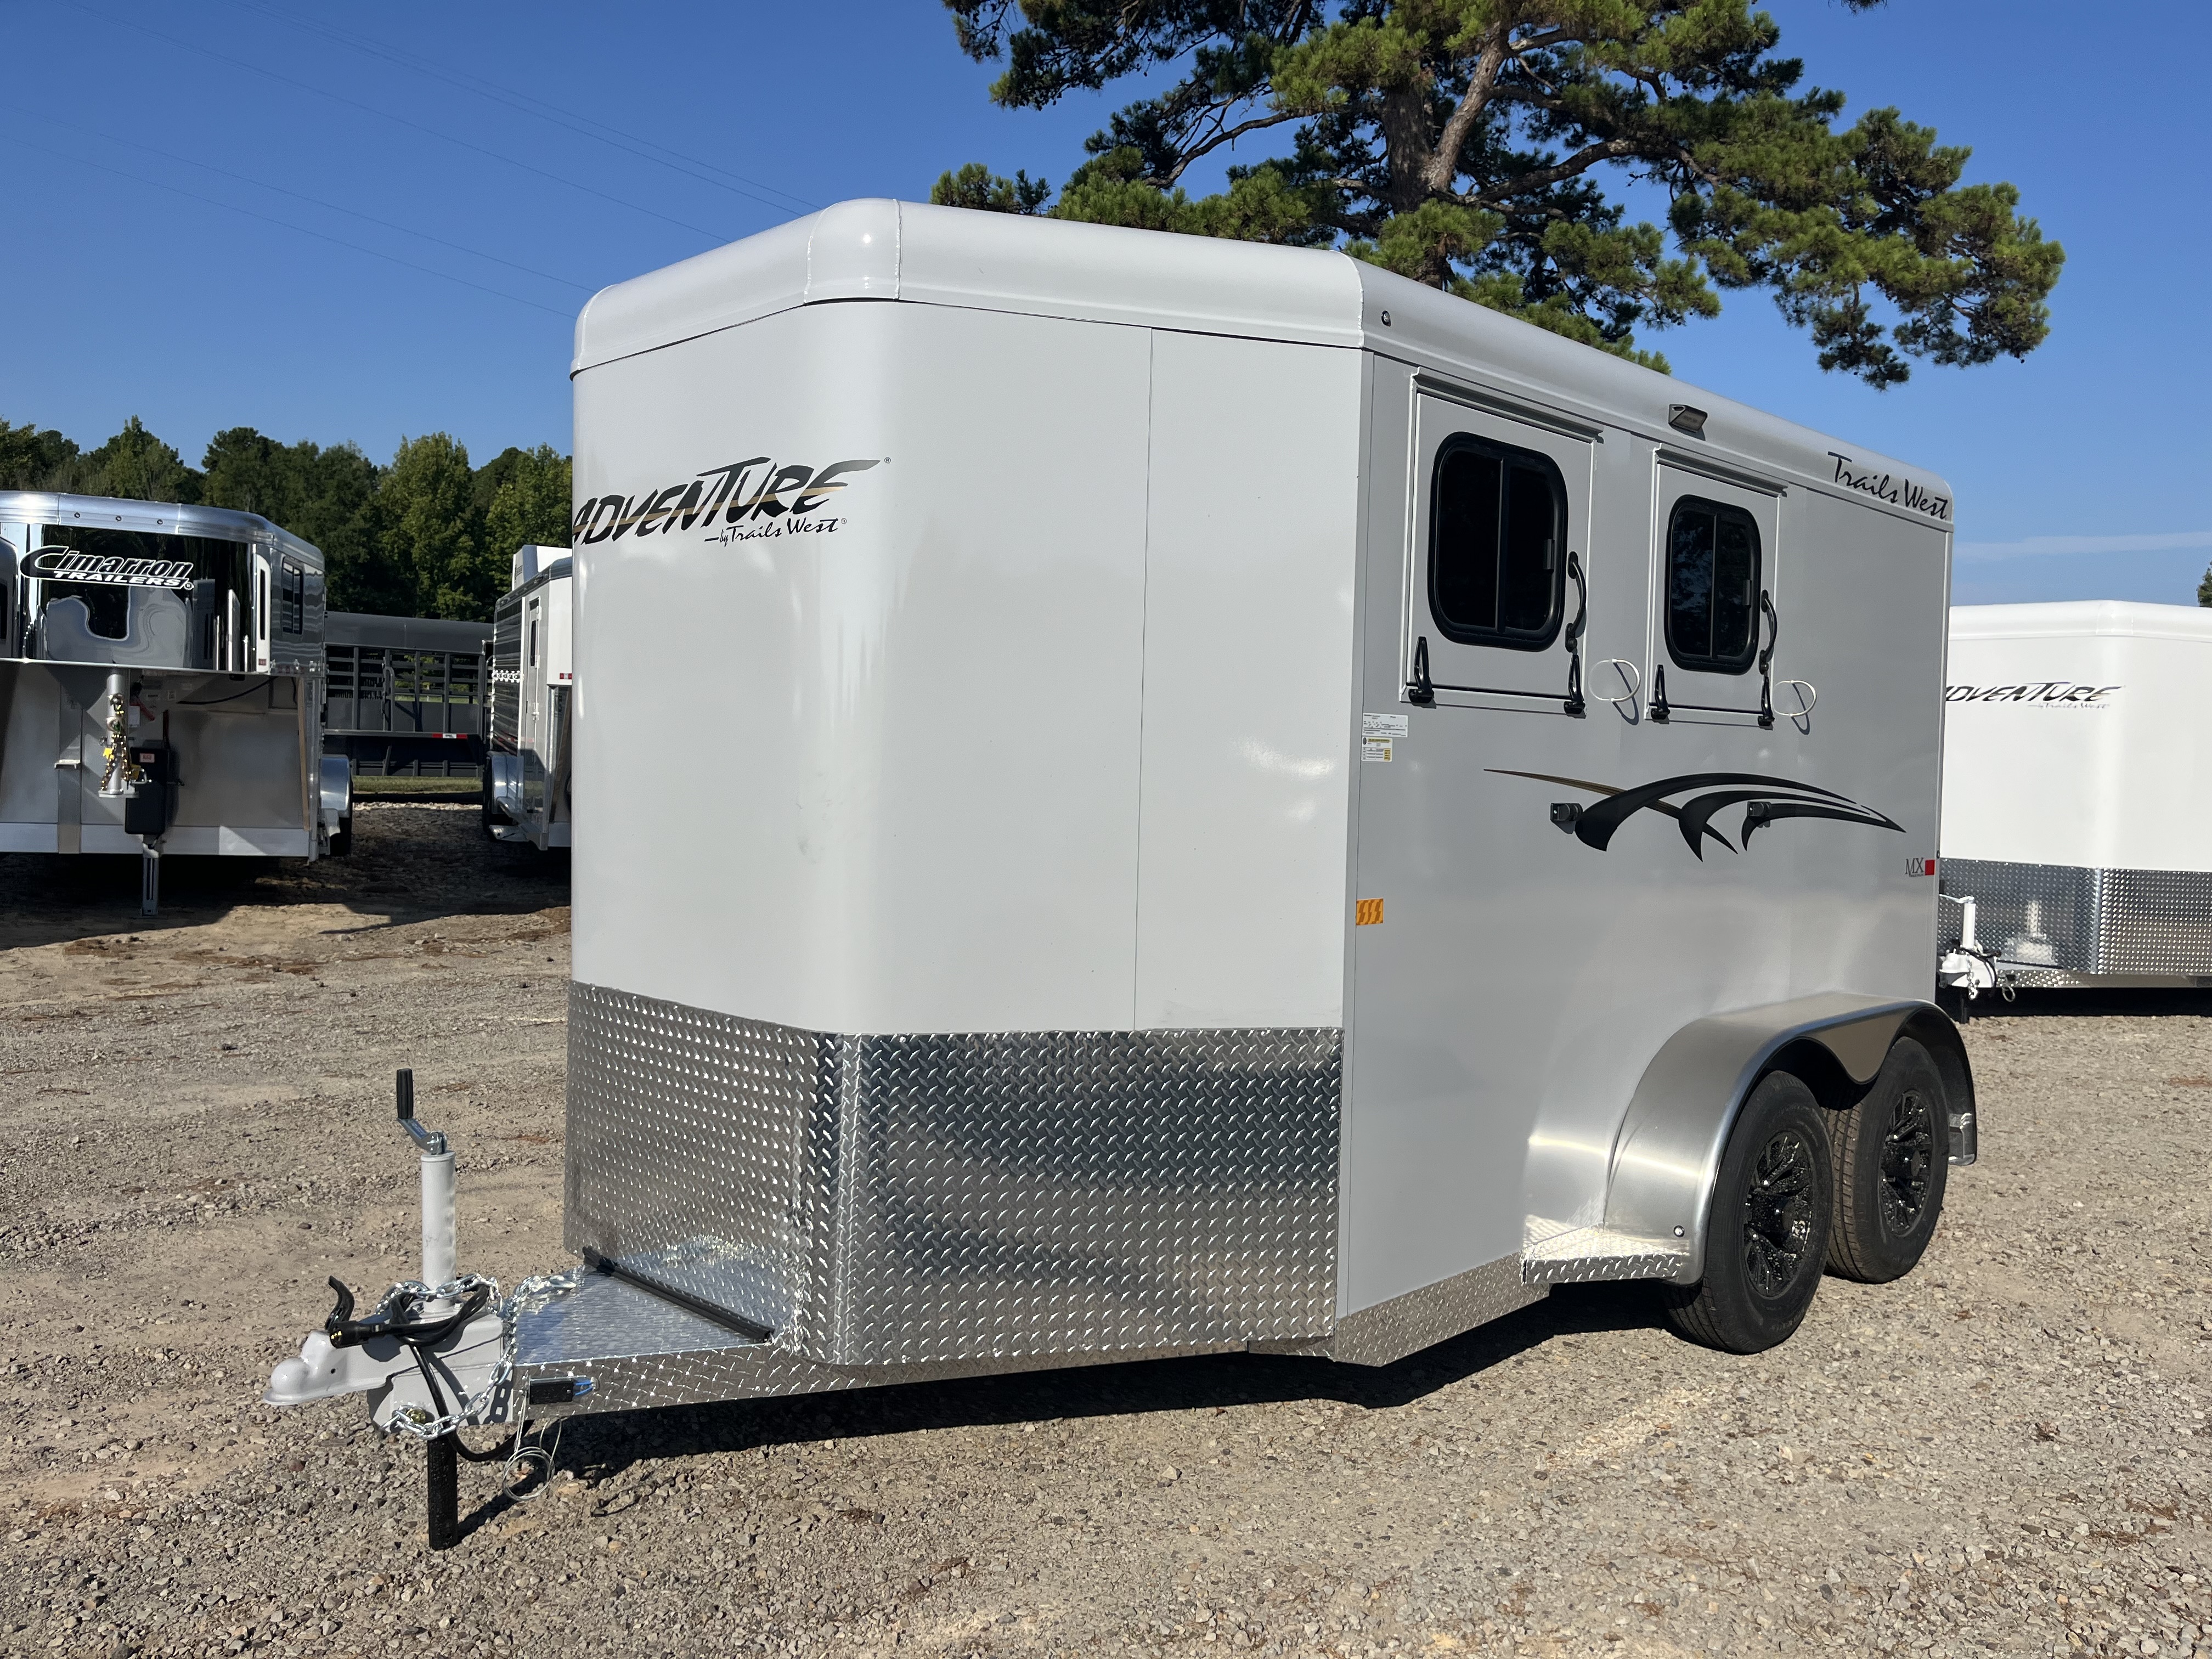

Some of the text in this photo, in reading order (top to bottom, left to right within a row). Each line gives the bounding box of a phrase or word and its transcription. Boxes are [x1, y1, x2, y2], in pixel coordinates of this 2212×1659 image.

[1827, 451, 1948, 519] Trails West
[572, 456, 881, 545] ADVENTURE
[726, 522, 782, 542] Trails
[787, 517, 838, 535] West
[20, 545, 194, 579] Cimarron
[54, 571, 184, 586] TRAILERS
[1905, 857, 1924, 875] MX
